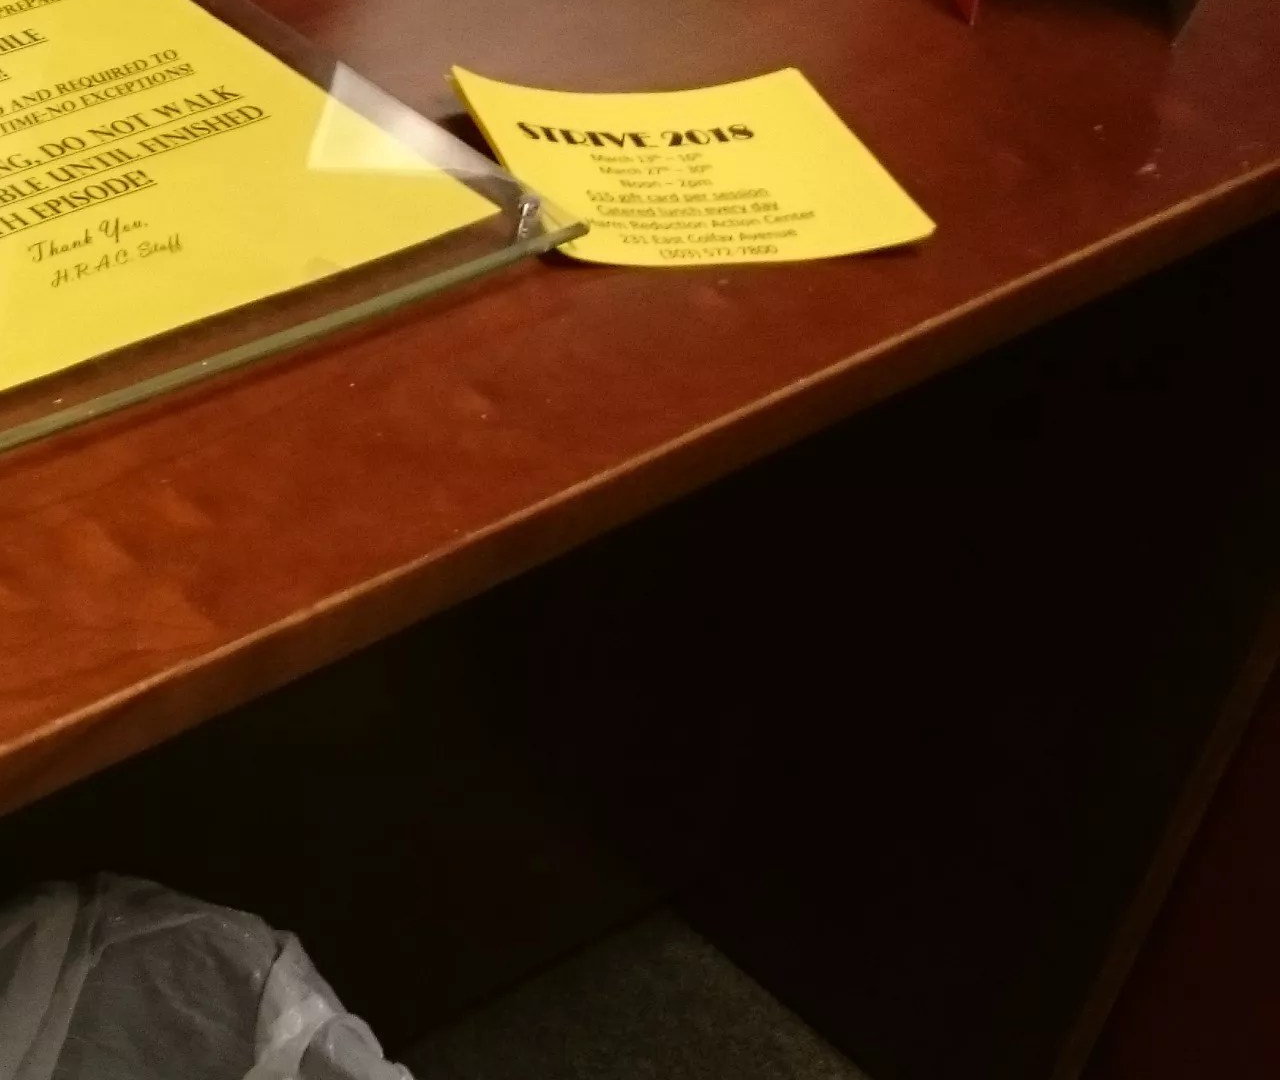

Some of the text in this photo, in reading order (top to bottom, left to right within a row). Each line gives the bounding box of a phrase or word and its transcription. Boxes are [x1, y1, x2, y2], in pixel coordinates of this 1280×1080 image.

[10, 88, 52, 112] AND
[55, 57, 149, 95] REQUIRED
[153, 49, 178, 66] TO
[80, 63, 195, 108] EXCEPTIONS!
[40, 135, 87, 160] DO
[88, 112, 152, 142] NOT
[46, 147, 140, 184] UNTIL
[137, 103, 266, 157] FINISHED
[660, 123, 755, 148] 2018
[28, 169, 156, 221] EPISODE!
[27, 228, 94, 263] Thank
